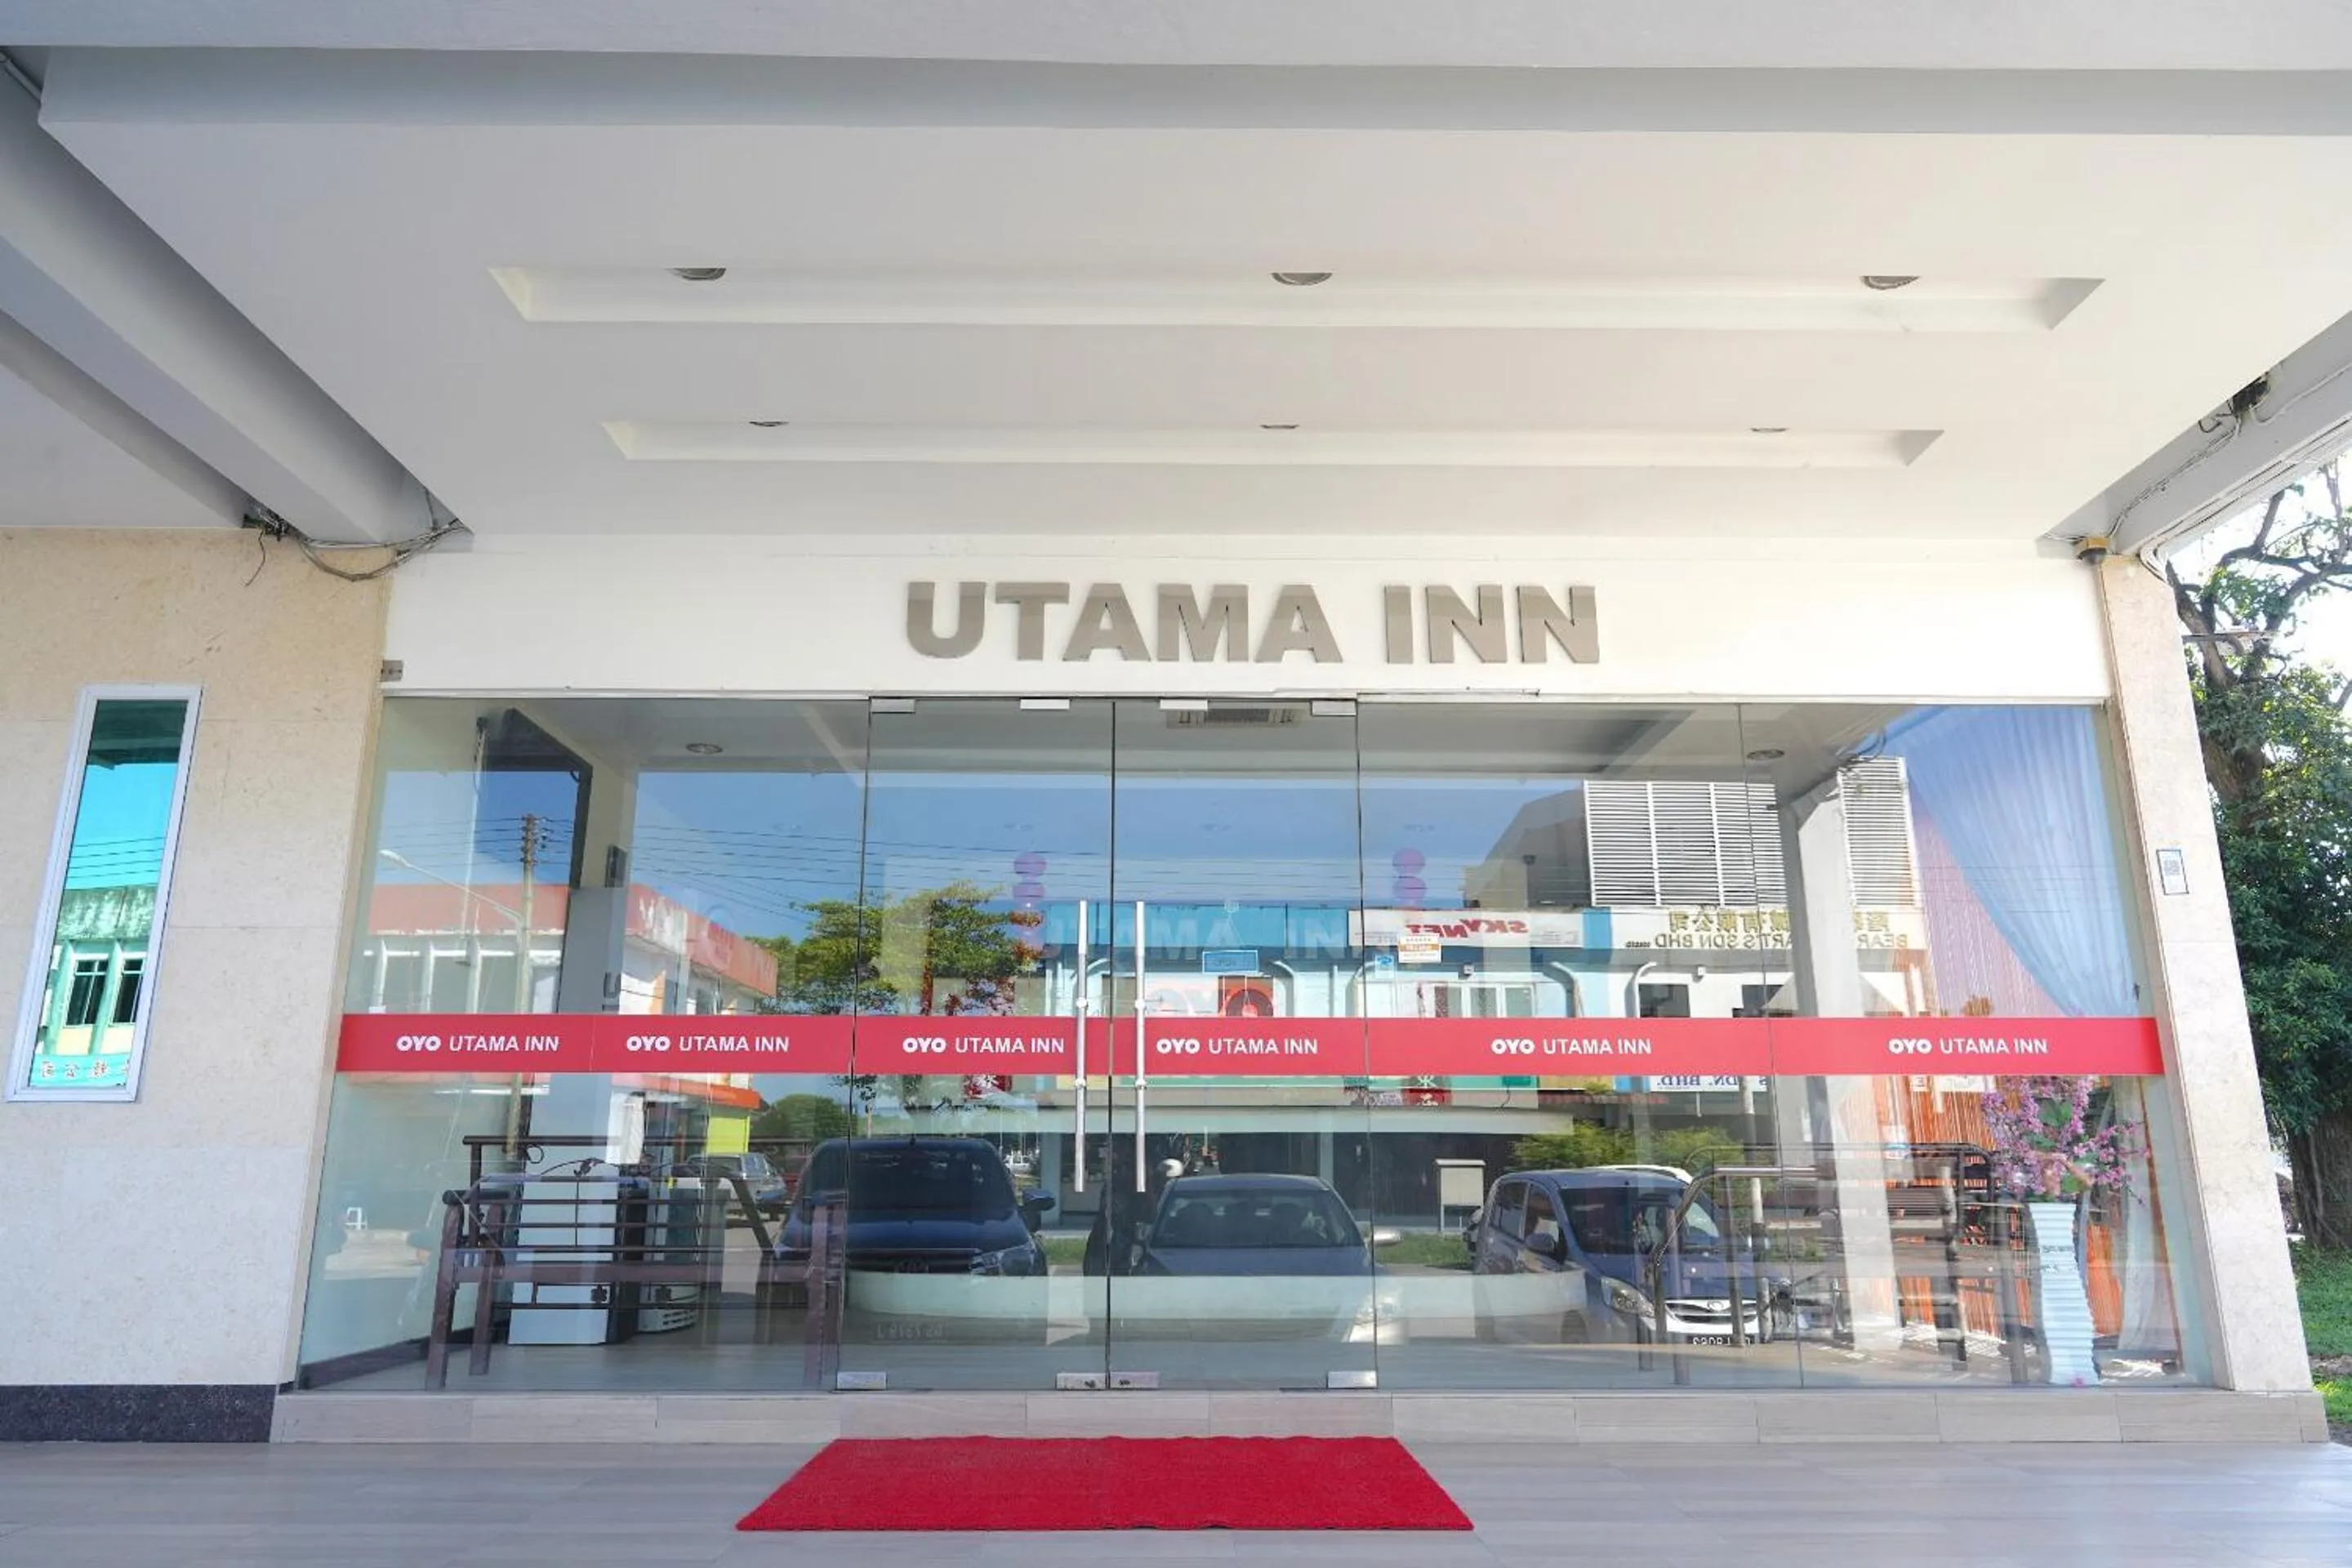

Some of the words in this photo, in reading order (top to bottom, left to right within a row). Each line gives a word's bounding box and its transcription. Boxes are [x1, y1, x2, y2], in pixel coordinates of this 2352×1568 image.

[906, 581, 1343, 663] UTAMA
[1383, 584, 1601, 665] INN
[395, 1036, 441, 1051] OYO
[448, 1036, 519, 1051] UTAMA
[524, 1036, 559, 1051] INN
[626, 1036, 670, 1051] OYO
[679, 1036, 749, 1051] UTAMA
[754, 1036, 789, 1051] INN
[902, 1037, 947, 1053] OYO
[955, 1037, 1025, 1053] UTAMA
[1030, 1037, 1064, 1053] INN
[1156, 1038, 1200, 1054] OYO
[1208, 1038, 1279, 1054] UTAMA
[1283, 1038, 1317, 1054] INN
[1490, 1038, 1535, 1054] OYO
[1542, 1038, 1614, 1054] UTAMA
[1617, 1038, 1652, 1054] INN
[1887, 1038, 1932, 1054] OYO
[1939, 1038, 2010, 1054] UTAMA
[2013, 1038, 2048, 1054] INN
